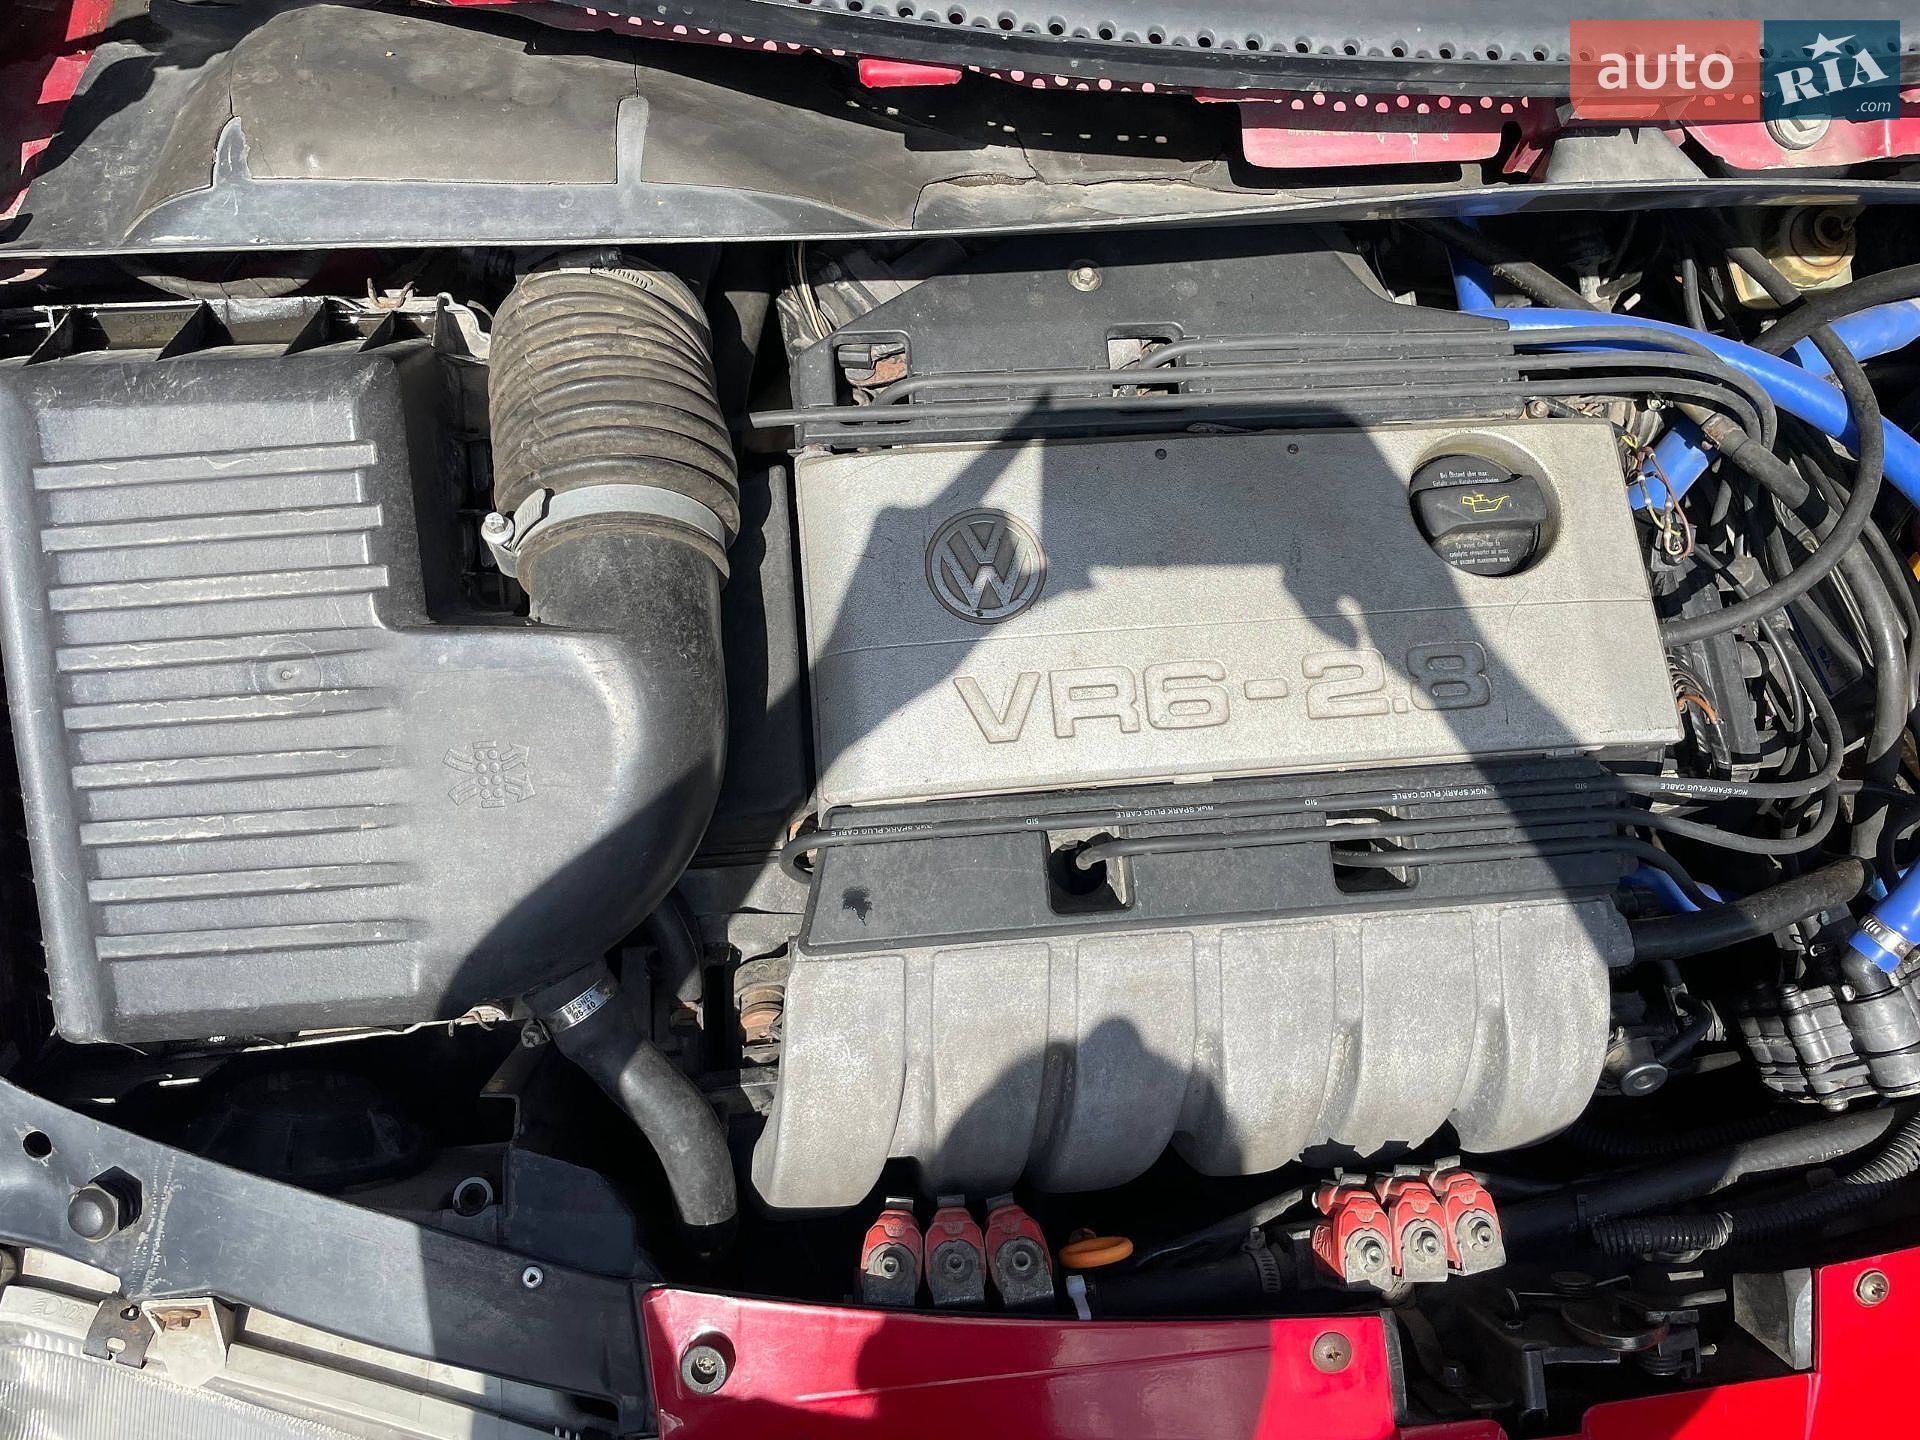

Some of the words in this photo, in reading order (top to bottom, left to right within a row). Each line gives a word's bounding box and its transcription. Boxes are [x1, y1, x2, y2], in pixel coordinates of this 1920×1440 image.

[954, 641, 1492, 744] VR6-2.8
[1660, 782, 1686, 791] CABLE
[1687, 784, 1708, 792] PLUG
[1391, 791, 1418, 800] CABLE
[1443, 788, 1469, 797] SPARK
[1115, 809, 1142, 819] CABLE
[1143, 808, 1166, 817] PLUG
[861, 827, 884, 835] PLUG
